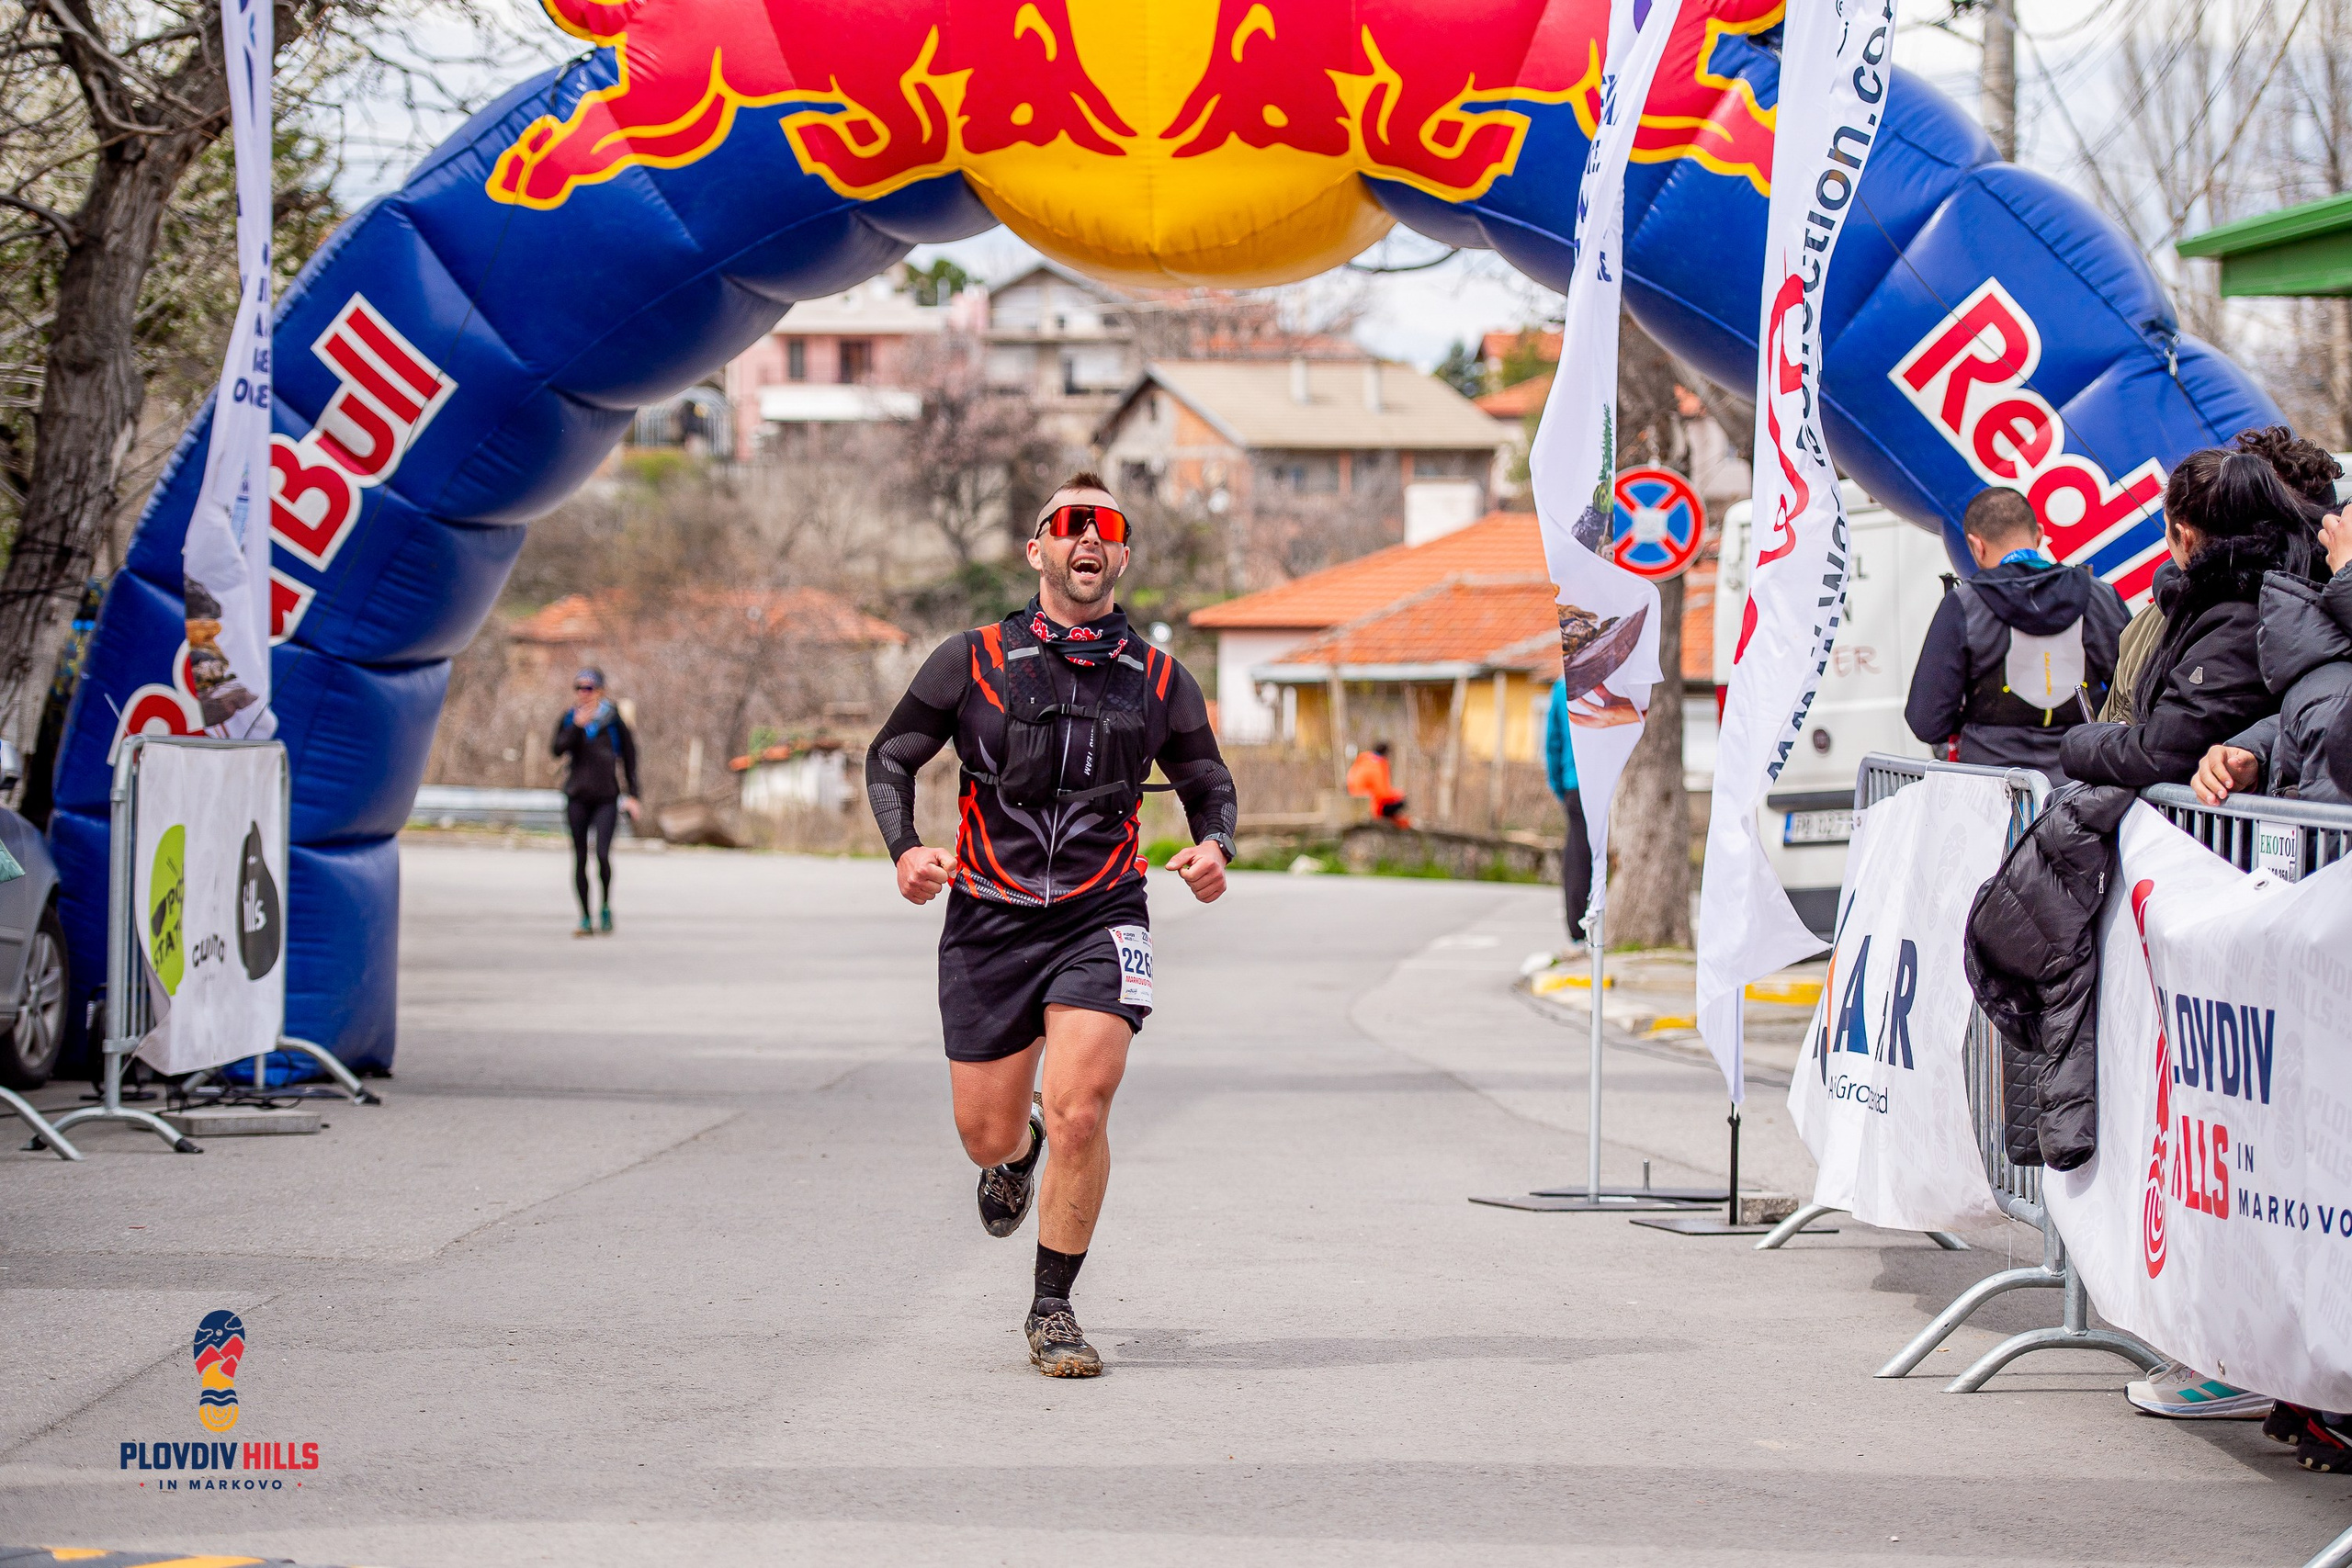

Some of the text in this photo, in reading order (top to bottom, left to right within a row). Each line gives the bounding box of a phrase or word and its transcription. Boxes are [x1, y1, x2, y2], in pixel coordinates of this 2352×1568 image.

[269, 296, 452, 566] Bull
[1893, 283, 2168, 565] Red
[2237, 1142, 2255, 1174] IN
[2238, 1187, 2352, 1238] MARKOVO
